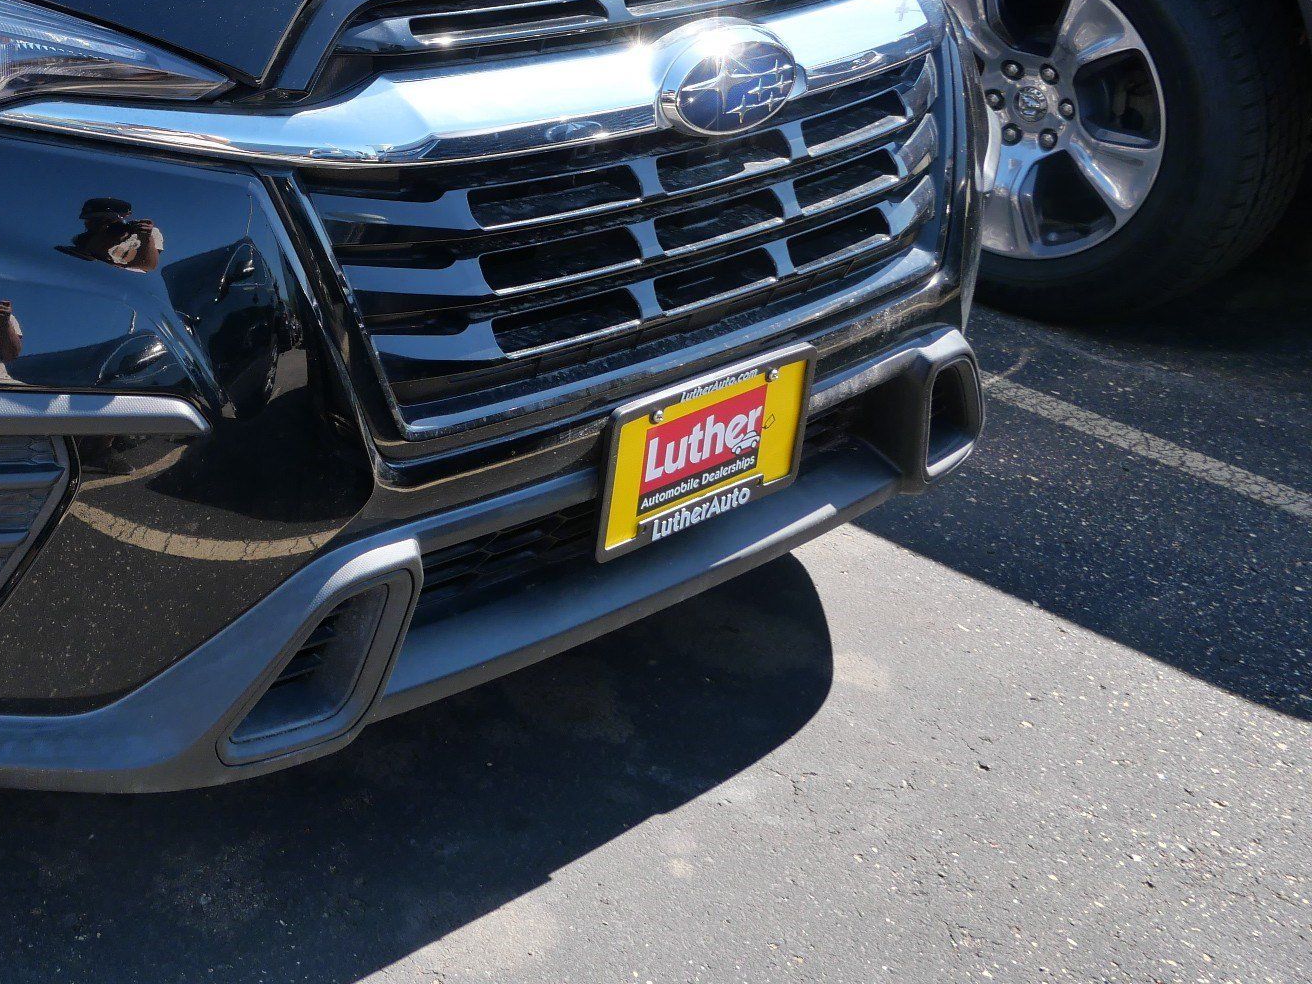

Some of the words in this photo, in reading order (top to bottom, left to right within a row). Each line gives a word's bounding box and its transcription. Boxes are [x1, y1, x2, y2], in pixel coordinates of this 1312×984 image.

[679, 368, 759, 404] LutherAuto.com
[644, 405, 764, 483] Luther
[640, 477, 699, 510] Automobile
[701, 455, 756, 486] Dealerships
[651, 487, 751, 542] LutherAuto
